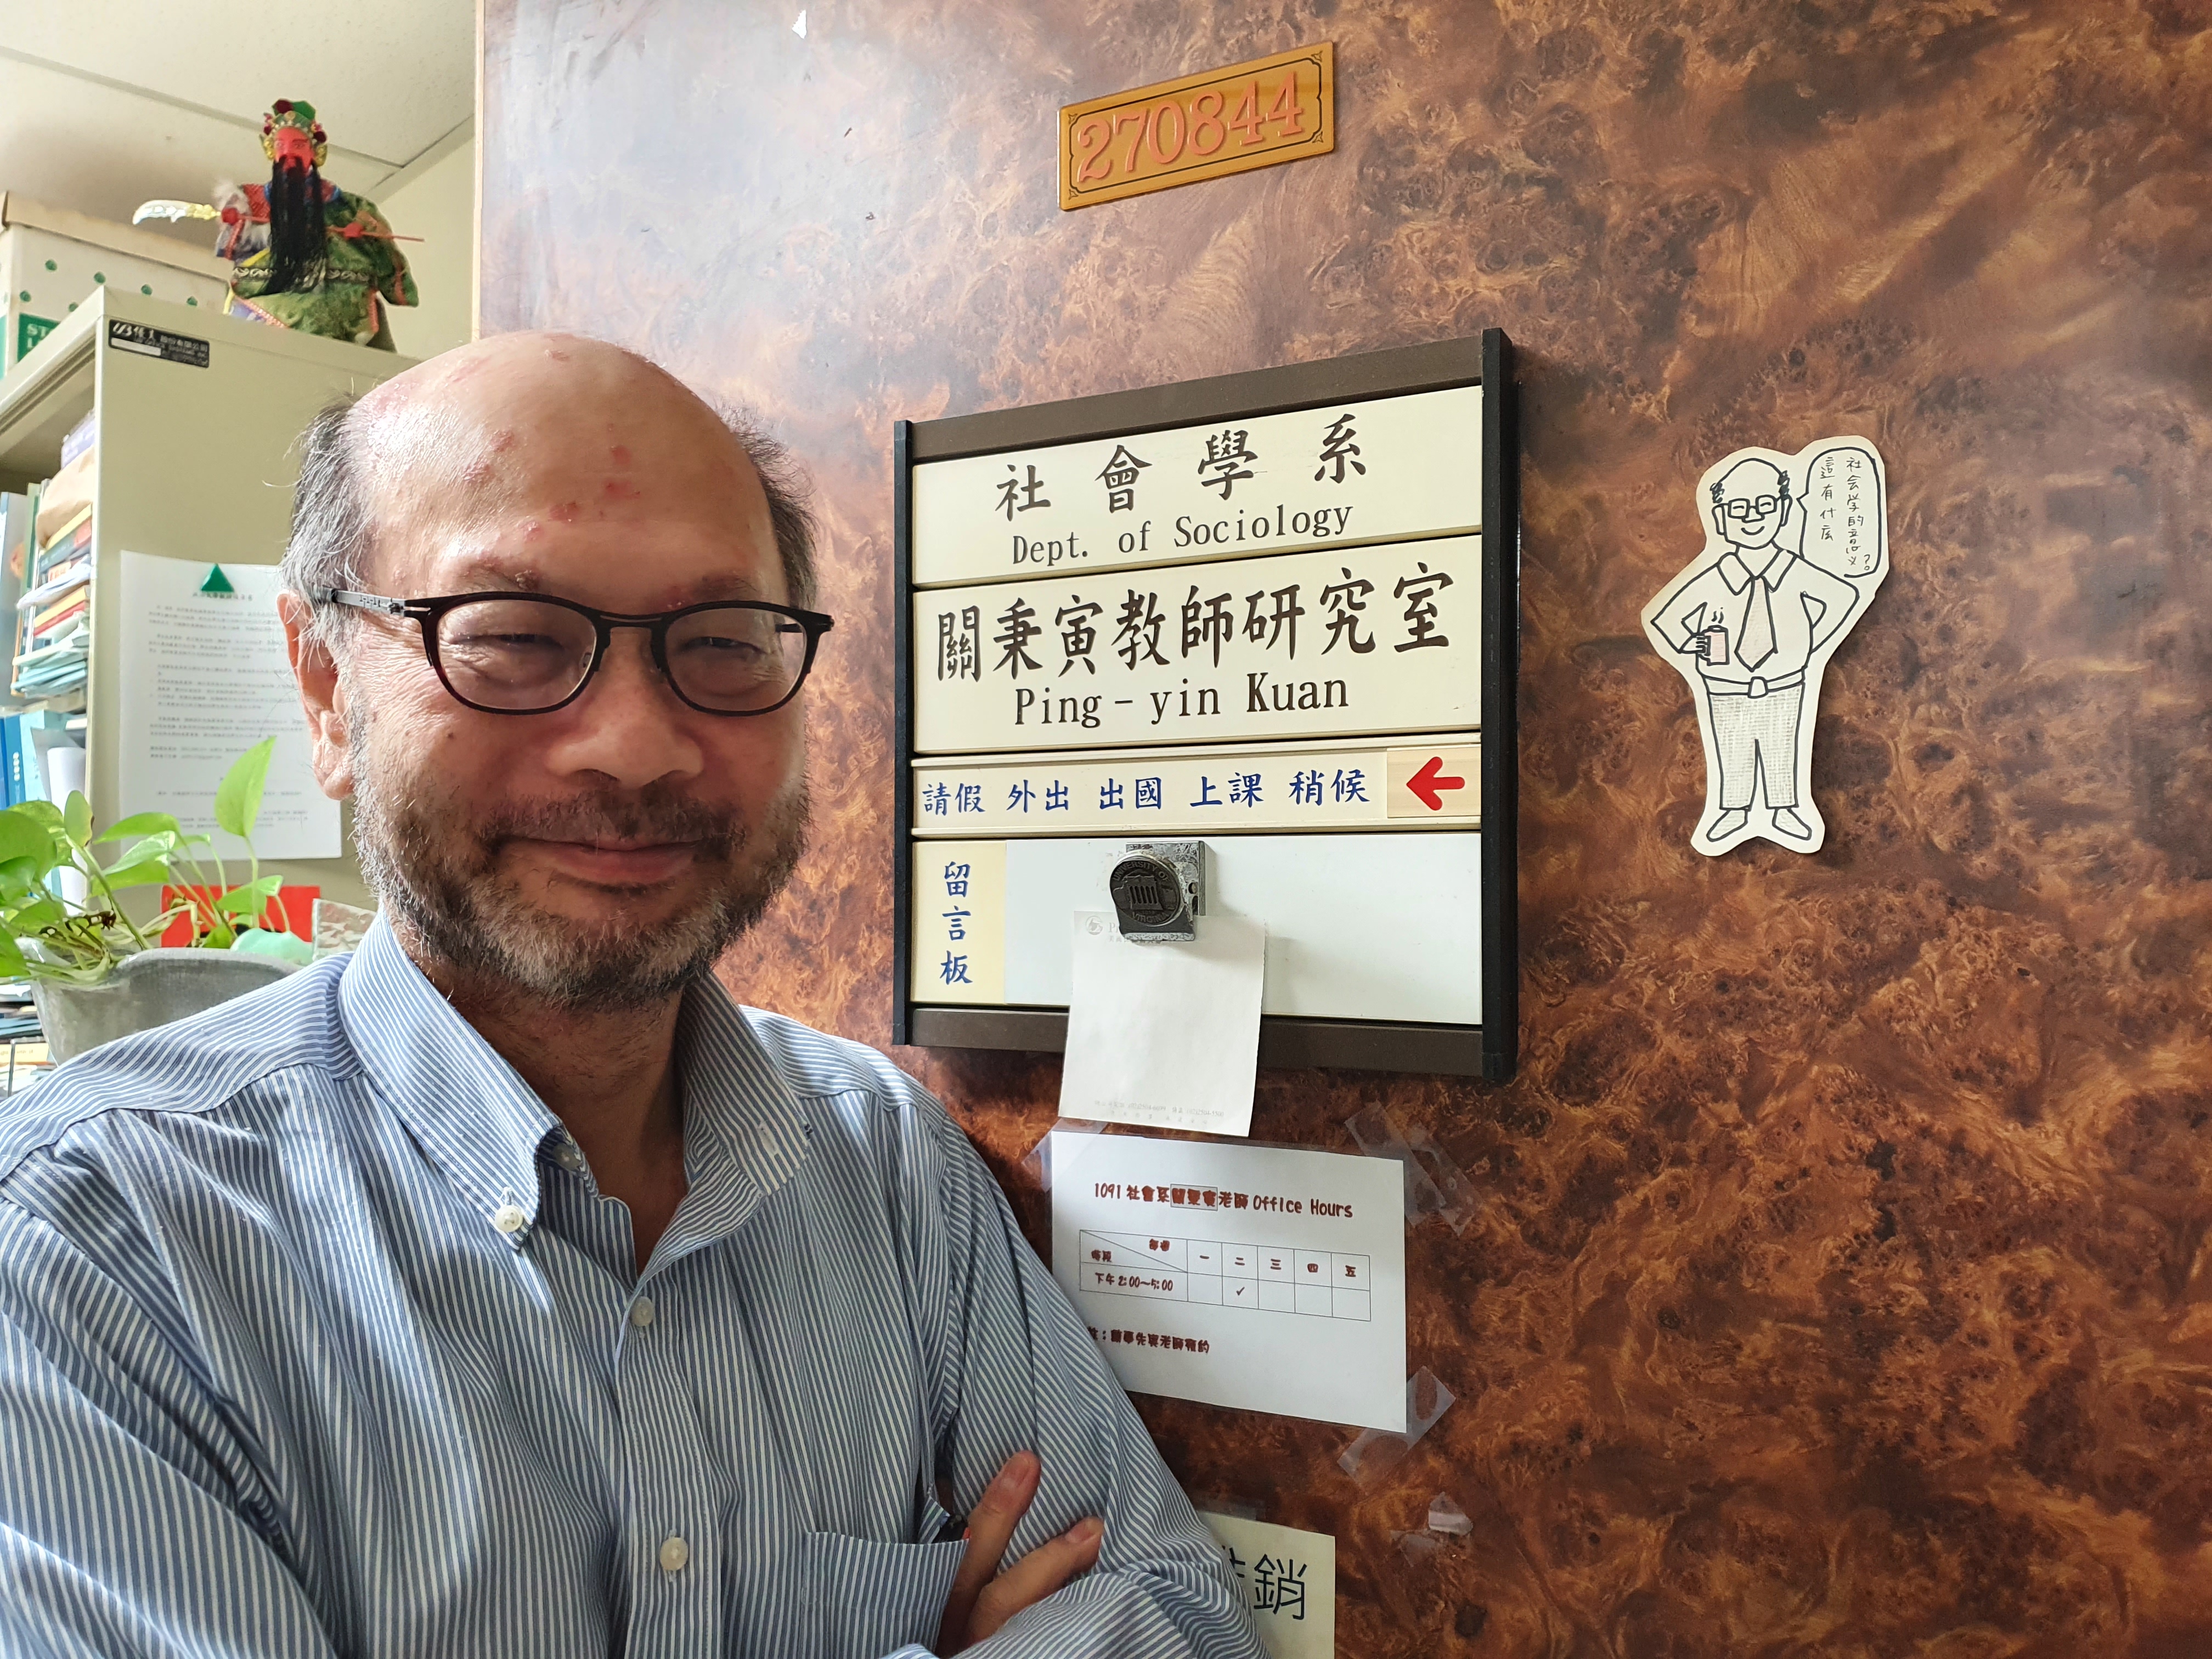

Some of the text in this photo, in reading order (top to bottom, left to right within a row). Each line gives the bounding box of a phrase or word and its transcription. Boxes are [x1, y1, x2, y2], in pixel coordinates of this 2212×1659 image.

[1077, 71, 1304, 183] 270844
[995, 413, 1366, 521] 社會學系
[1012, 504, 1353, 566] Dept. of Sociology
[937, 561, 1454, 682] 關秉寅教師研究室
[1246, 672, 1349, 712] Kuan
[922, 769, 1370, 816] 請假 外出 出國 上課 稍候
[1113, 861, 1171, 882] UNIVERSITY OF
[940, 861, 973, 985] 留言板
[1095, 1183, 1121, 1199] 1091
[1253, 1195, 1302, 1214] Office
[1311, 1198, 1353, 1218] Hours
[1234, 1257, 1245, 1266] 二
[1270, 1259, 1282, 1270] 三
[1307, 1263, 1319, 1273] 四
[1345, 1265, 1356, 1277] 五
